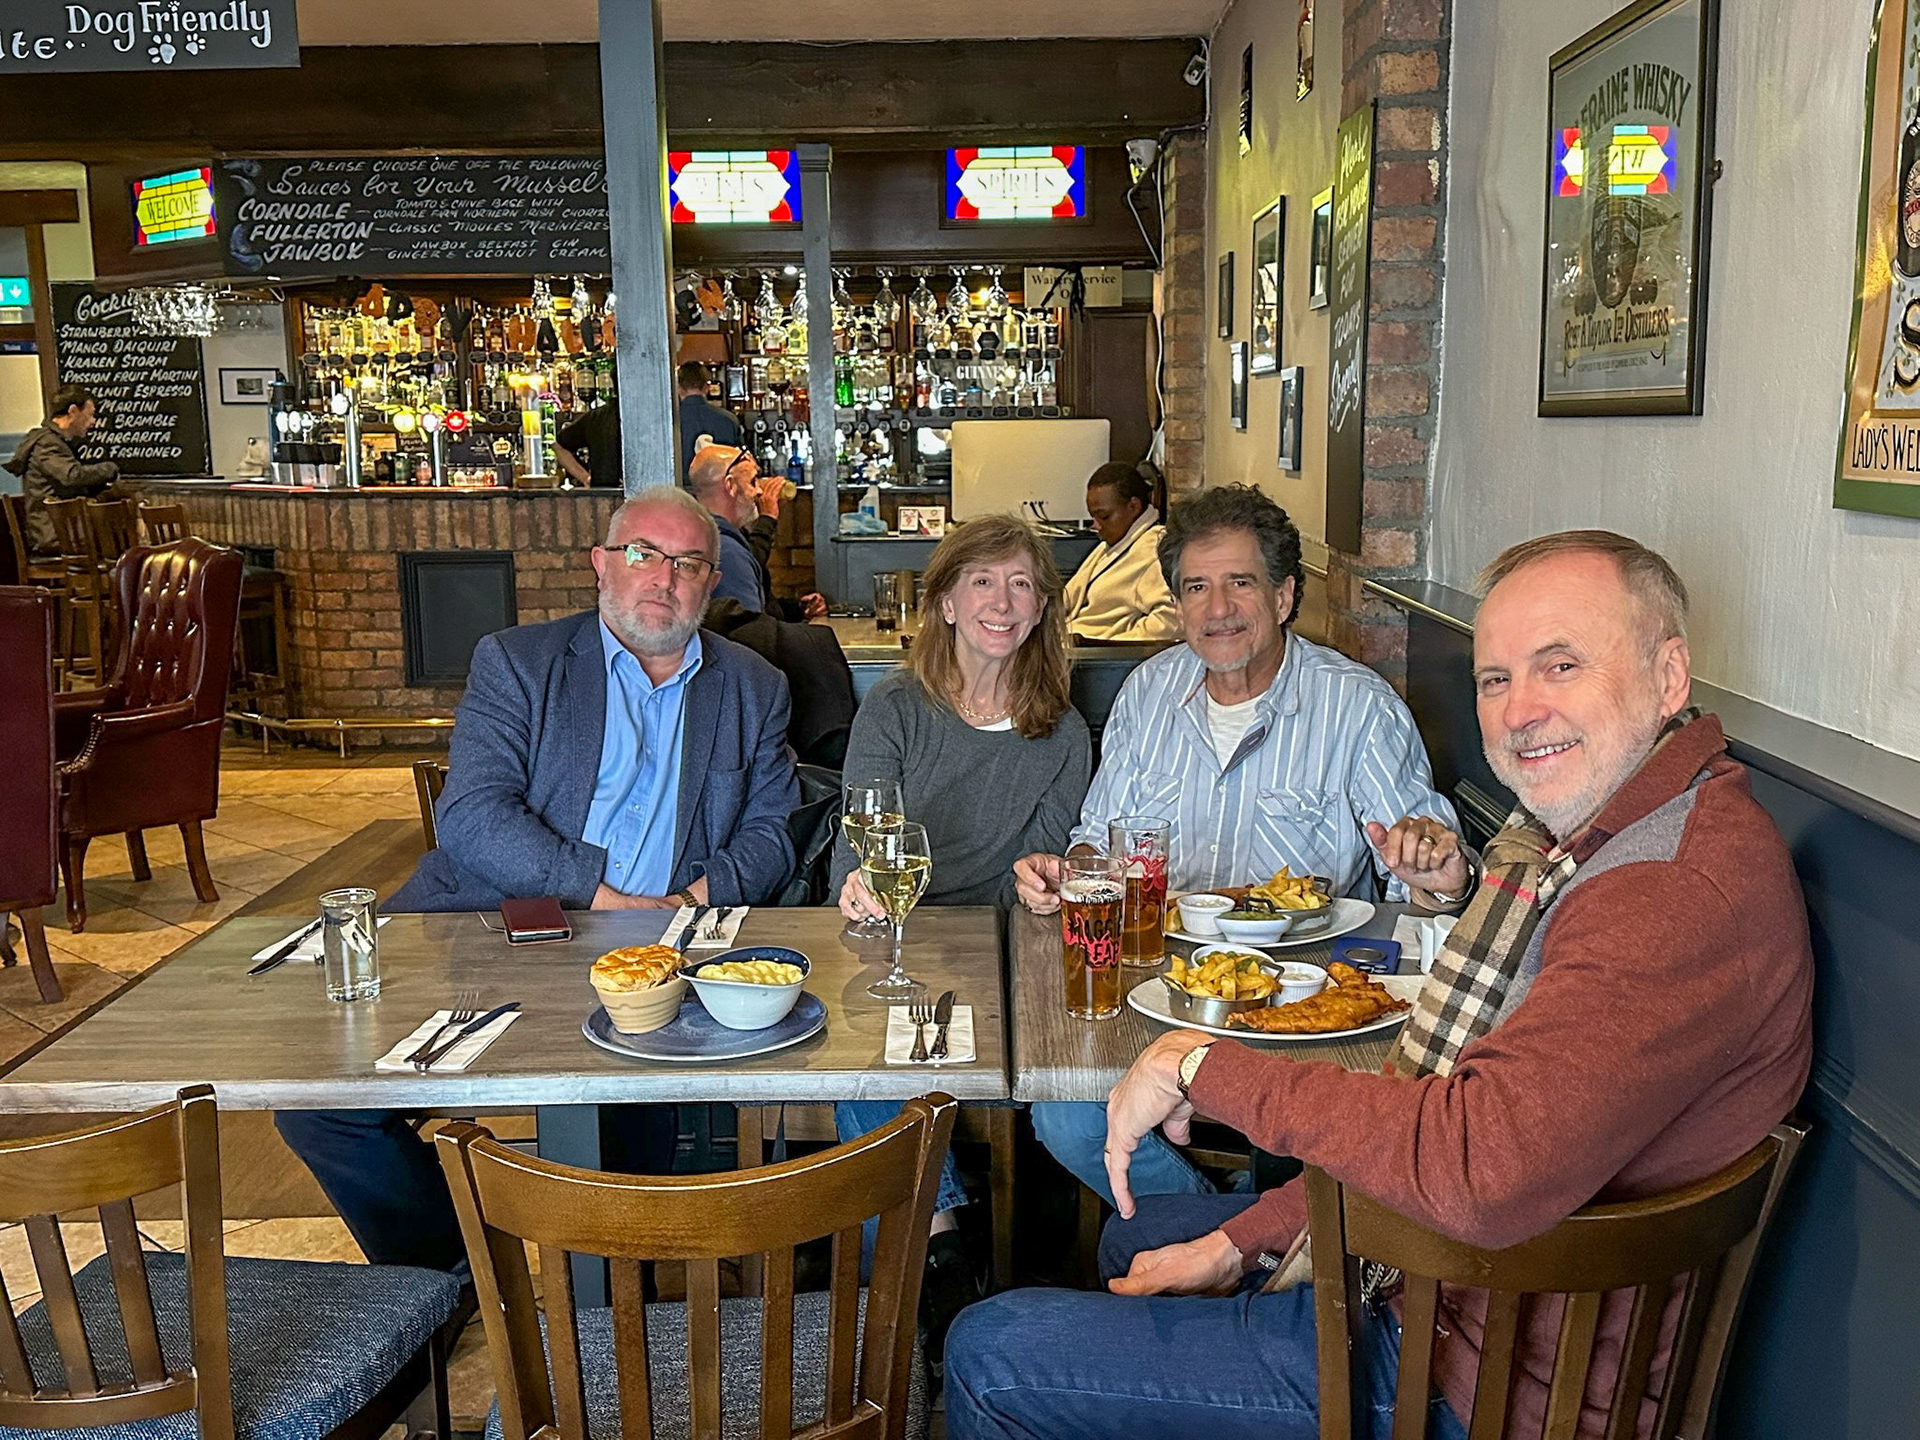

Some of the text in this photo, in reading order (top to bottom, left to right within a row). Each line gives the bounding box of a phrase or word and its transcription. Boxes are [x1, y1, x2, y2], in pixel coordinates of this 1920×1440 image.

[65, 0, 272, 52] Dog Friendly
[1575, 62, 1692, 145] ERAINE WHISKY
[308, 160, 603, 173] PLEASE CHOOSE ONE OFF THE FOLLOWING
[267, 165, 351, 196] Sauces
[363, 174, 401, 197] for
[414, 176, 477, 197] Your
[976, 170, 1056, 194] SPIRITS
[146, 193, 200, 223] WELCOME
[238, 199, 351, 220] CORNDALE
[395, 198, 438, 209] TOMATO
[450, 198, 486, 209] CHIVE
[491, 198, 526, 208] BASE
[531, 198, 564, 208] WITH
[373, 209, 426, 219] CORNDALE
[462, 208, 519, 219] NORTHERN
[523, 208, 555, 218] IRISH
[249, 221, 374, 241] FULLERTON
[387, 222, 442, 235] CLASSIC
[447, 221, 514, 232] MOULES
[264, 241, 364, 263] JAWBOX
[411, 239, 579, 251] JAWBOX BELFAST GIN
[386, 248, 442, 260] GINGER
[464, 248, 537, 259] COCONUT
[548, 248, 608, 259] CREAM
[1032, 273, 1117, 285] Wairs ervice
[60, 323, 140, 338] STRAWBERRY
[59, 339, 177, 355] MANGO DAIQUIRI
[64, 354, 168, 368] KRAKEN STORM
[64, 368, 198, 383] PASSION FRUIT MARTINI
[956, 365, 1014, 380] GUINNE
[85, 384, 192, 399] ELNUT ESPRESSO
[98, 400, 160, 413] MARTINI
[114, 413, 178, 429] BRAMBLE
[86, 430, 171, 444] MARGARITA
[109, 444, 182, 459] FASHIONED
[1852, 423, 1890, 470] LADY'S
[1083, 940, 1119, 968] LEAP
